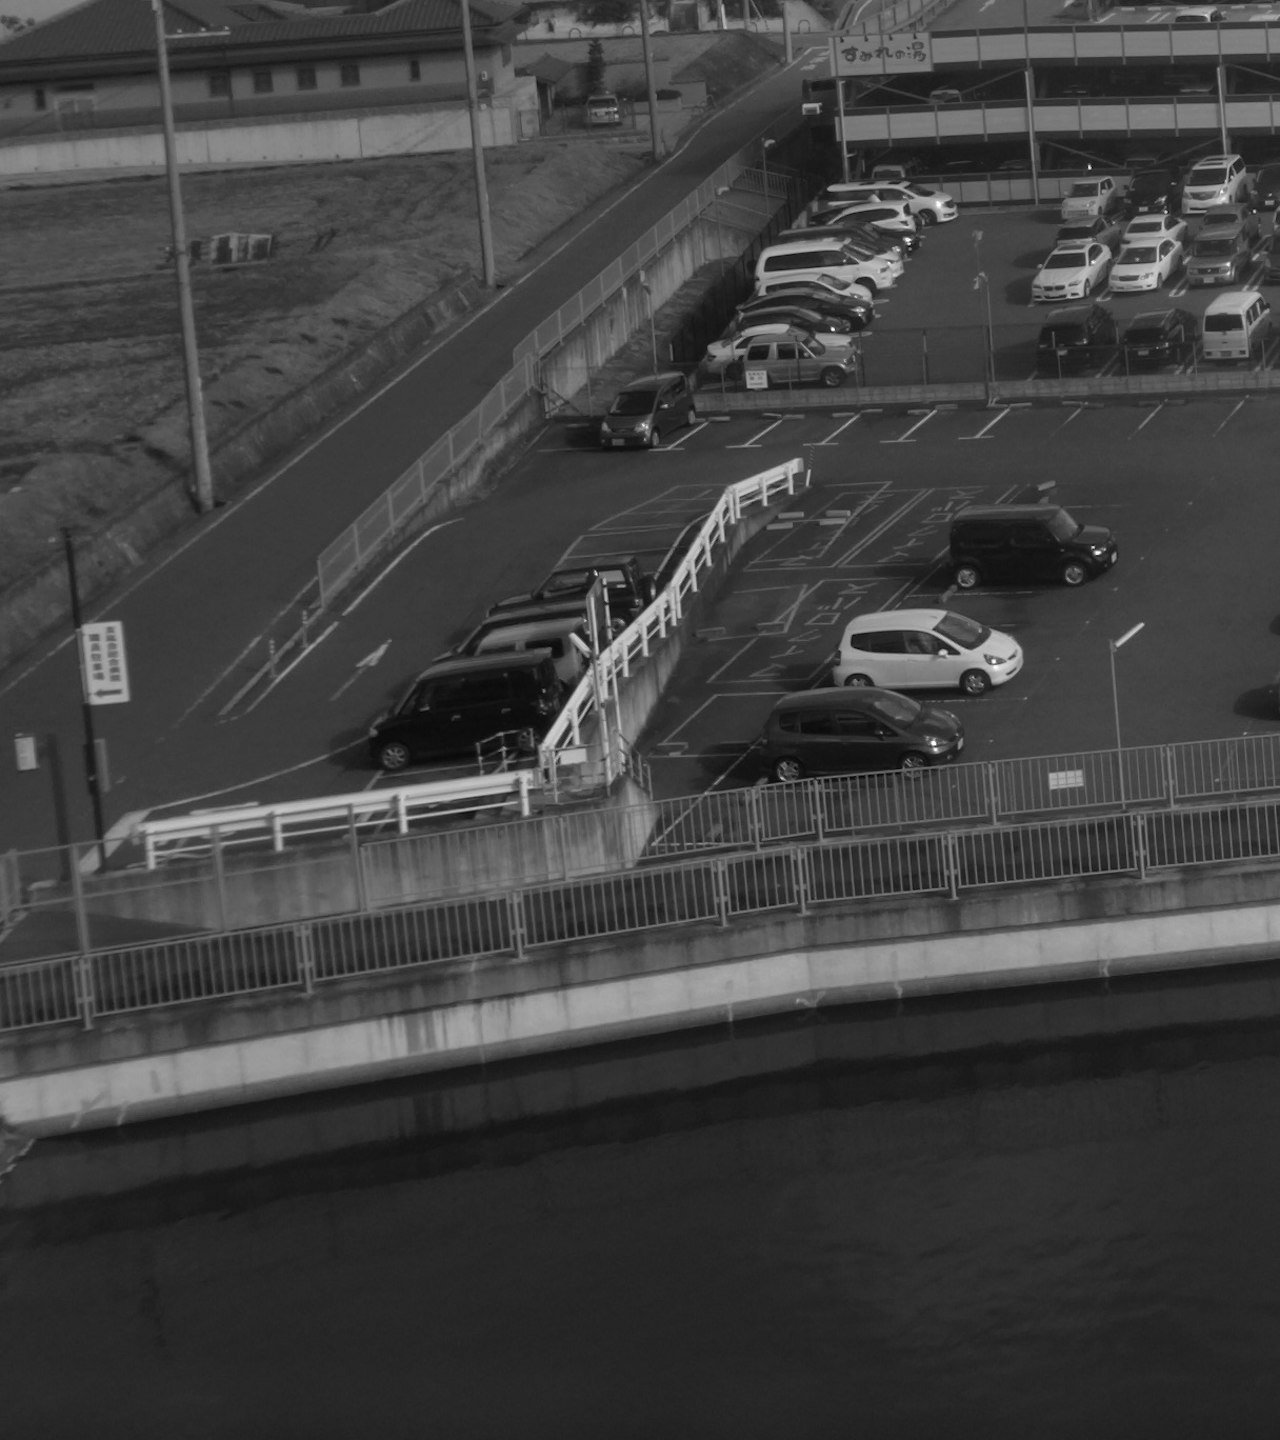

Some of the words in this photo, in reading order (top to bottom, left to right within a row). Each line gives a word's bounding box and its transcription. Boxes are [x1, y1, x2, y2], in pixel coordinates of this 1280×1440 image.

[841, 41, 927, 62] すみれの湯
